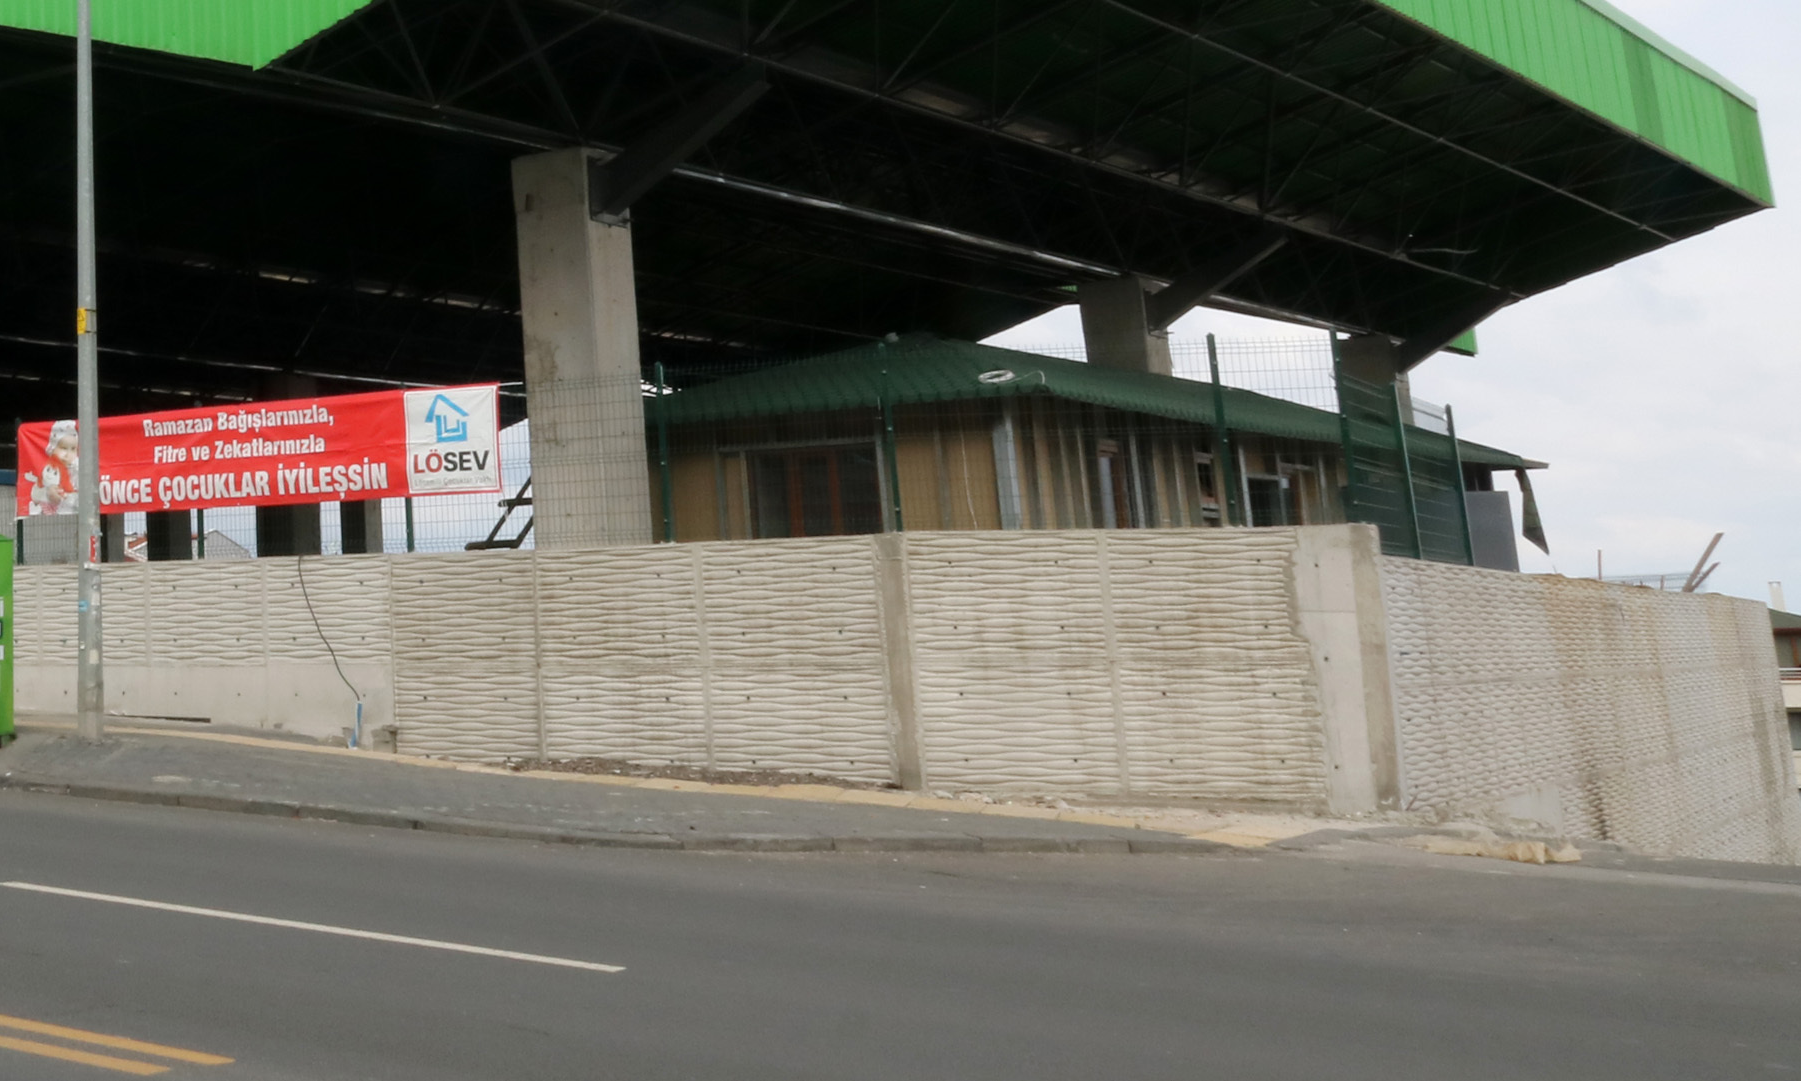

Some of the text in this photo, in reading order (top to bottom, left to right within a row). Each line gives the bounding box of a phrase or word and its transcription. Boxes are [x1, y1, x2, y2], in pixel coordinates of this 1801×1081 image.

[143, 404, 334, 437] Ramazan Bağışlarınızla,
[153, 434, 325, 464] Fitre ve Zekatlarınızla
[413, 449, 489, 473] LÖSEV
[99, 457, 388, 509] ÖNCE ÇOCUKLAR İYİLEŞSİN
